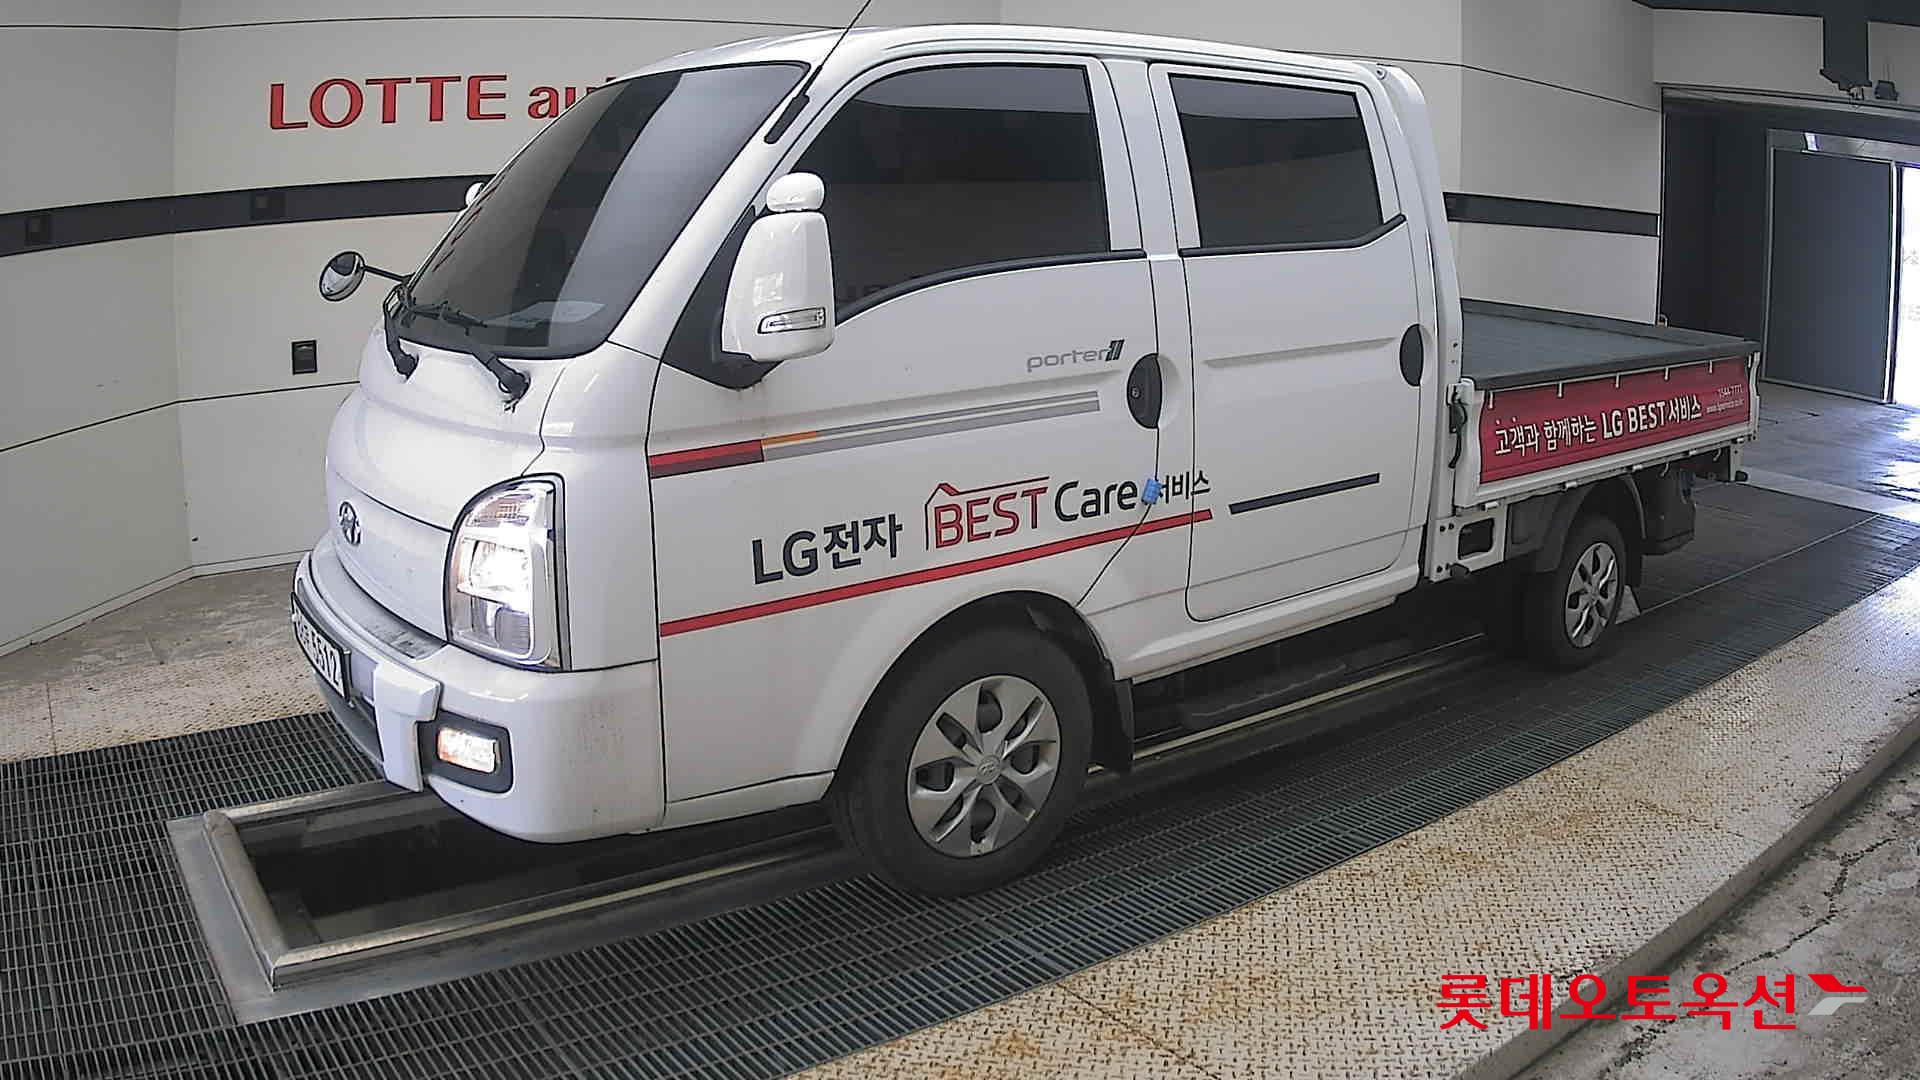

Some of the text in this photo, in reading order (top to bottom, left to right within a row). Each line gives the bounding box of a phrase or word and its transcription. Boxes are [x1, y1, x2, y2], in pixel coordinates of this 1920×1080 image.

[269, 75, 508, 130] LOTTE
[1495, 423, 1540, 457] 고객과
[1543, 415, 1597, 451] 함께하는
[1601, 410, 1624, 439] LG
[1627, 401, 1666, 433] BEST
[1668, 394, 1702, 423] 서비스
[751, 513, 904, 585] LG전자
[934, 486, 1049, 549] BEST
[1054, 480, 1138, 523] Care
